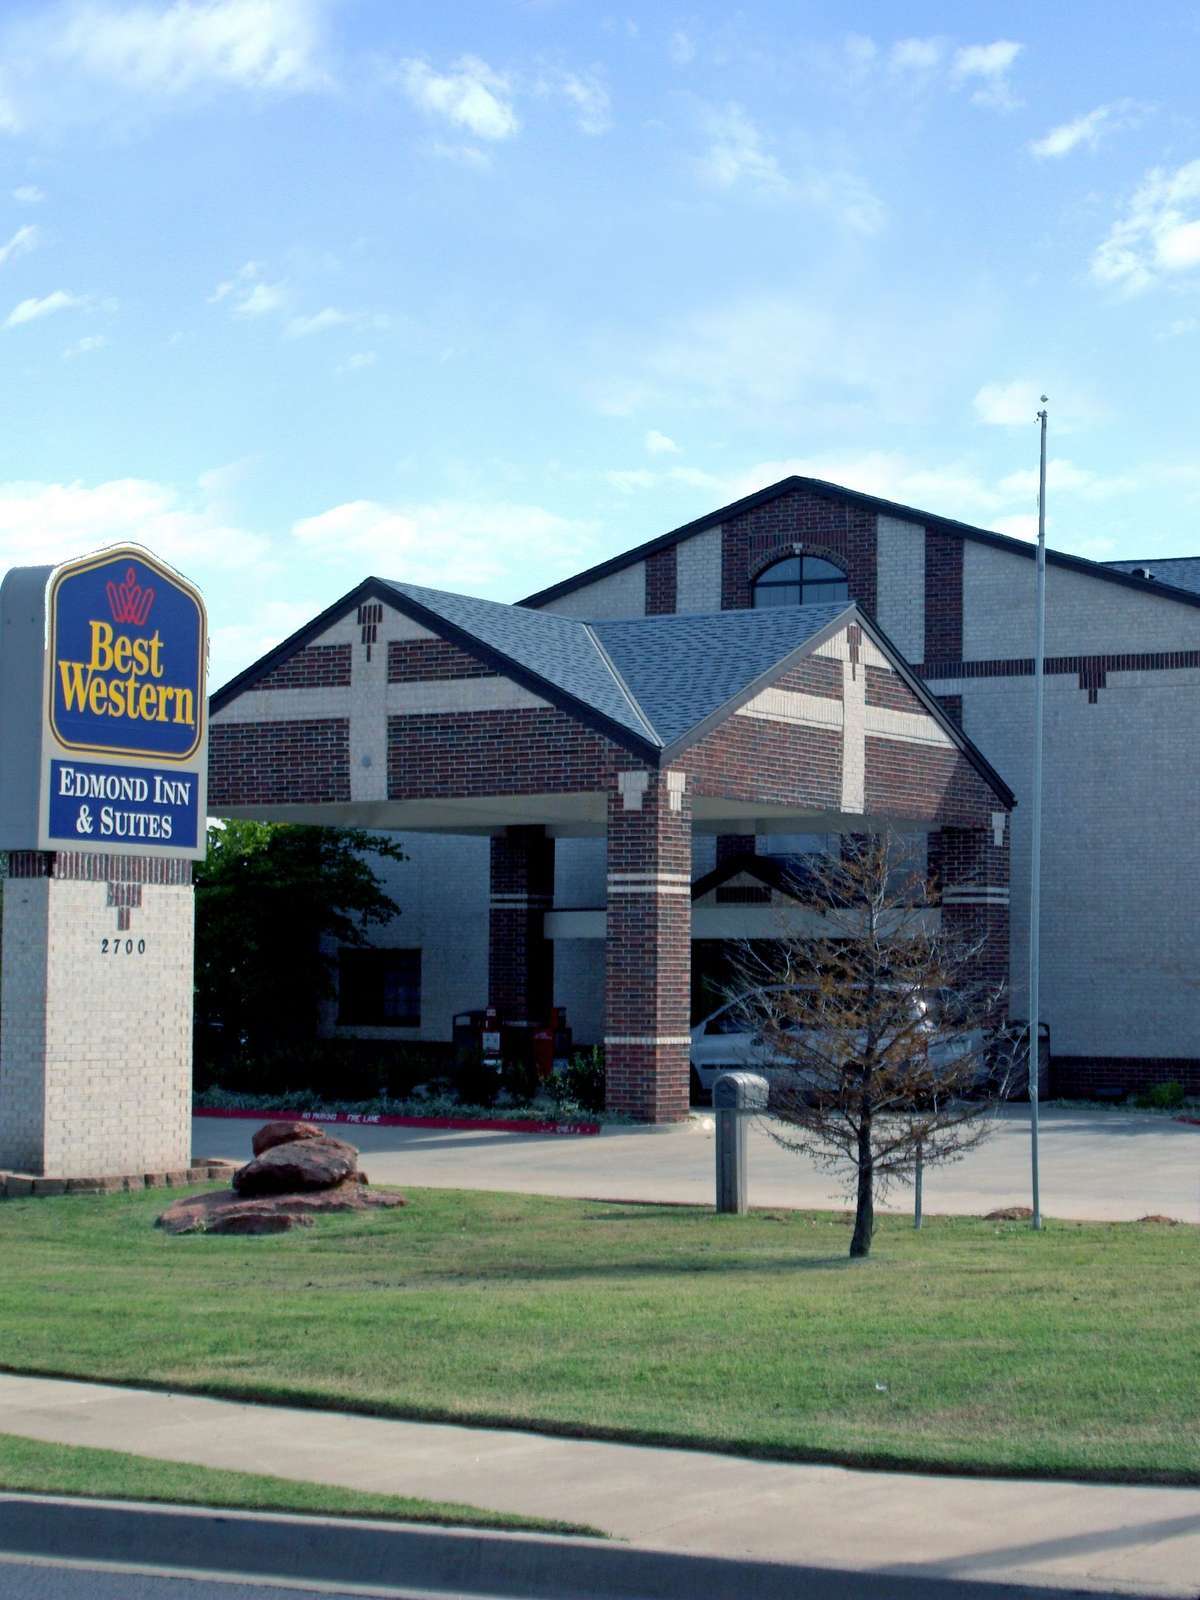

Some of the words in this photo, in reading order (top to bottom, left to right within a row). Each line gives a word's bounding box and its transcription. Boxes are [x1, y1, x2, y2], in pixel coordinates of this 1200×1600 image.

[89, 620, 164, 678] Best
[58, 660, 195, 725] Western
[58, 767, 148, 802] EDMOND
[153, 775, 191, 806] INN
[76, 804, 94, 834] &
[100, 806, 172, 839] SUITES
[101, 938, 146, 955] 2700
